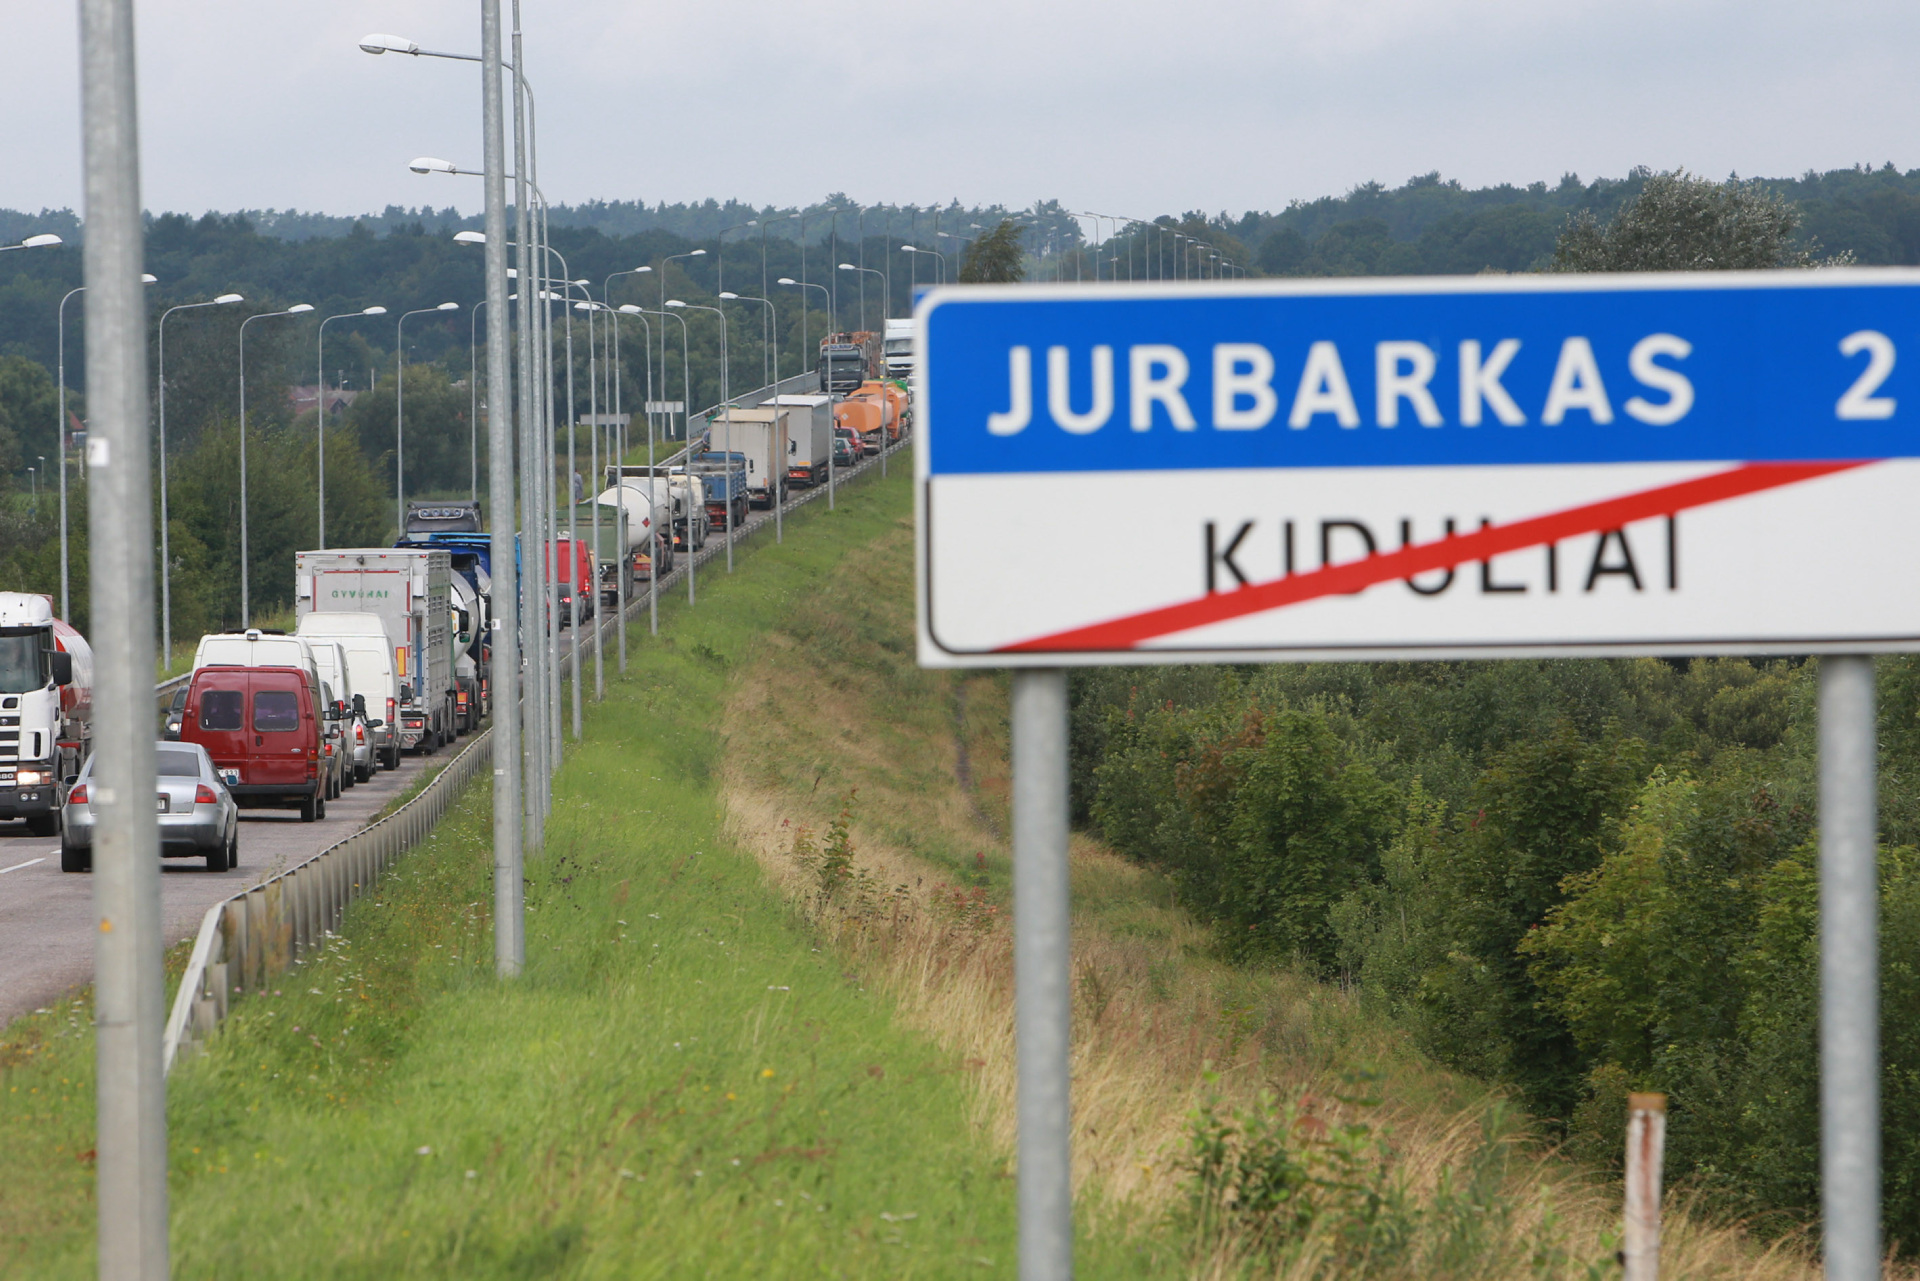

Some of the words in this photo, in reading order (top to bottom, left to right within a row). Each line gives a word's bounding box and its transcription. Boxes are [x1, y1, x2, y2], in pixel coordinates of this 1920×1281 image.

[987, 333, 1694, 436] JURBARKAS
[1836, 330, 1896, 420] 2
[1204, 516, 1678, 597] KIDULIAI
